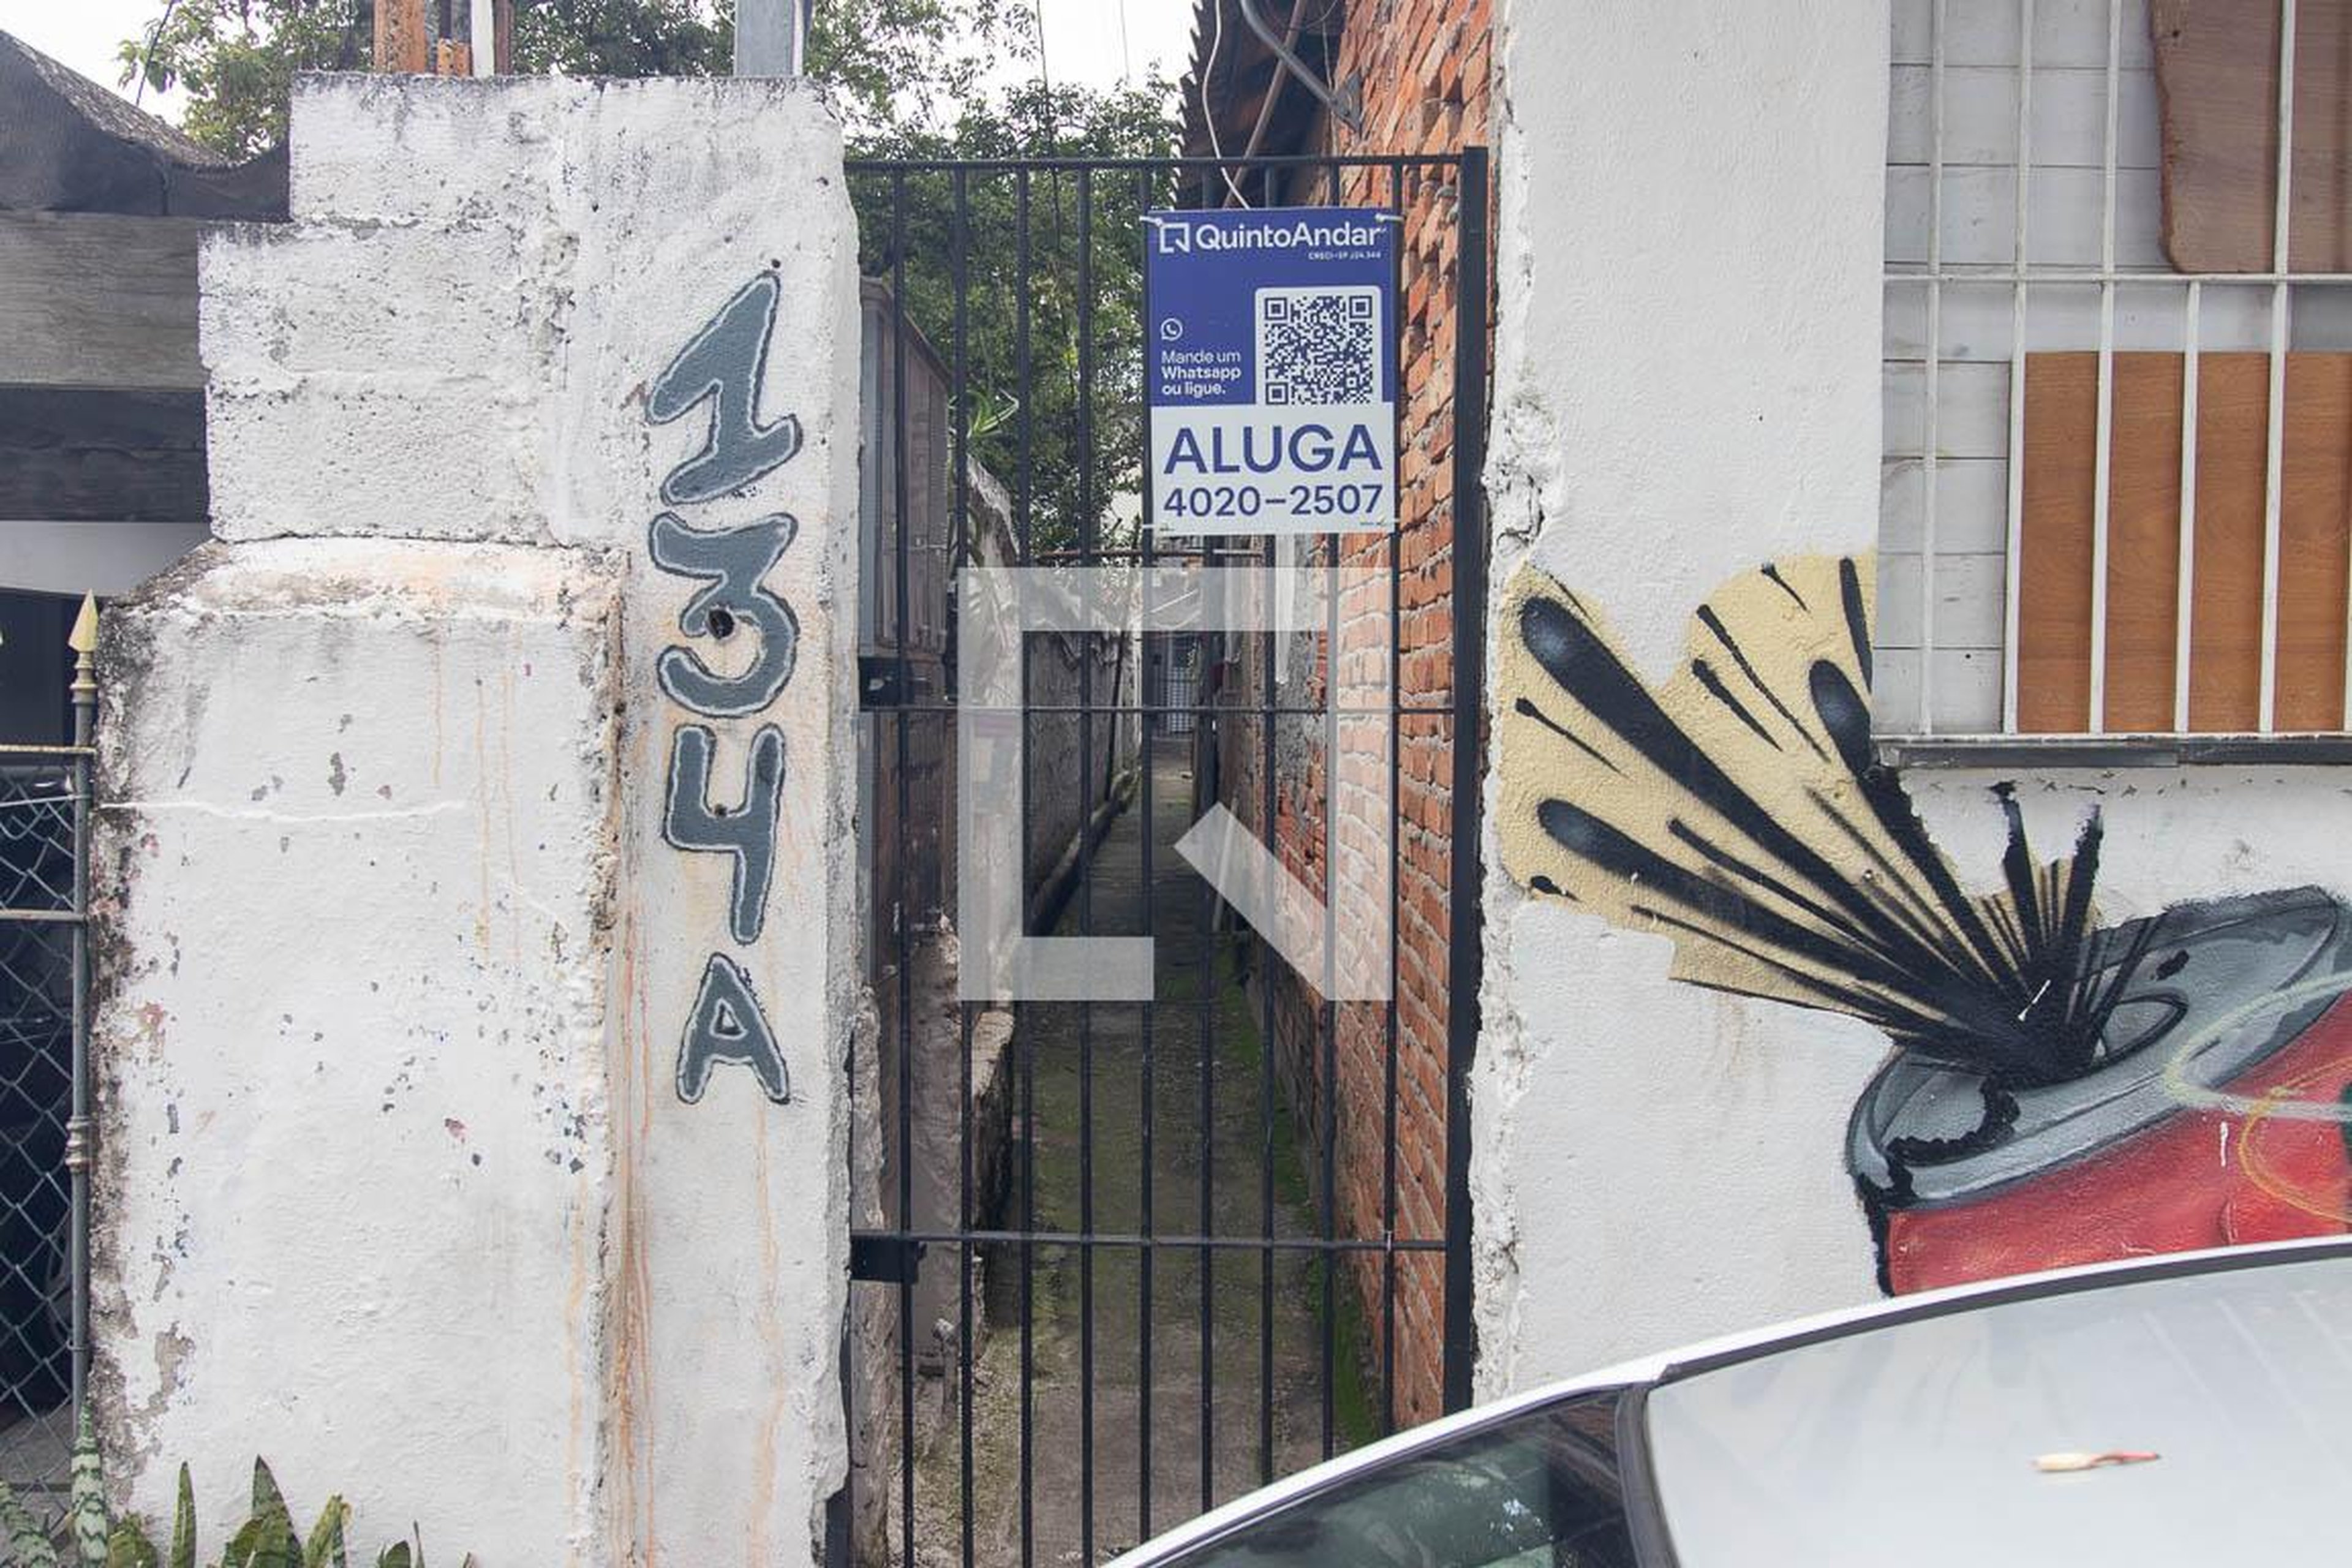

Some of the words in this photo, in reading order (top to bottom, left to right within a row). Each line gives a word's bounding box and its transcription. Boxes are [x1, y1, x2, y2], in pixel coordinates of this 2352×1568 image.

[1195, 221, 1381, 251] QuintoAndar
[1161, 350, 1214, 364] Mande
[1216, 351, 1241, 363] um
[1161, 366, 1242, 382] Whatsapp
[1161, 383, 1182, 396] ou
[1184, 381, 1226, 399] ligue.
[1163, 424, 1383, 475] ALUGA
[1164, 484, 1383, 518] 4020-2507
